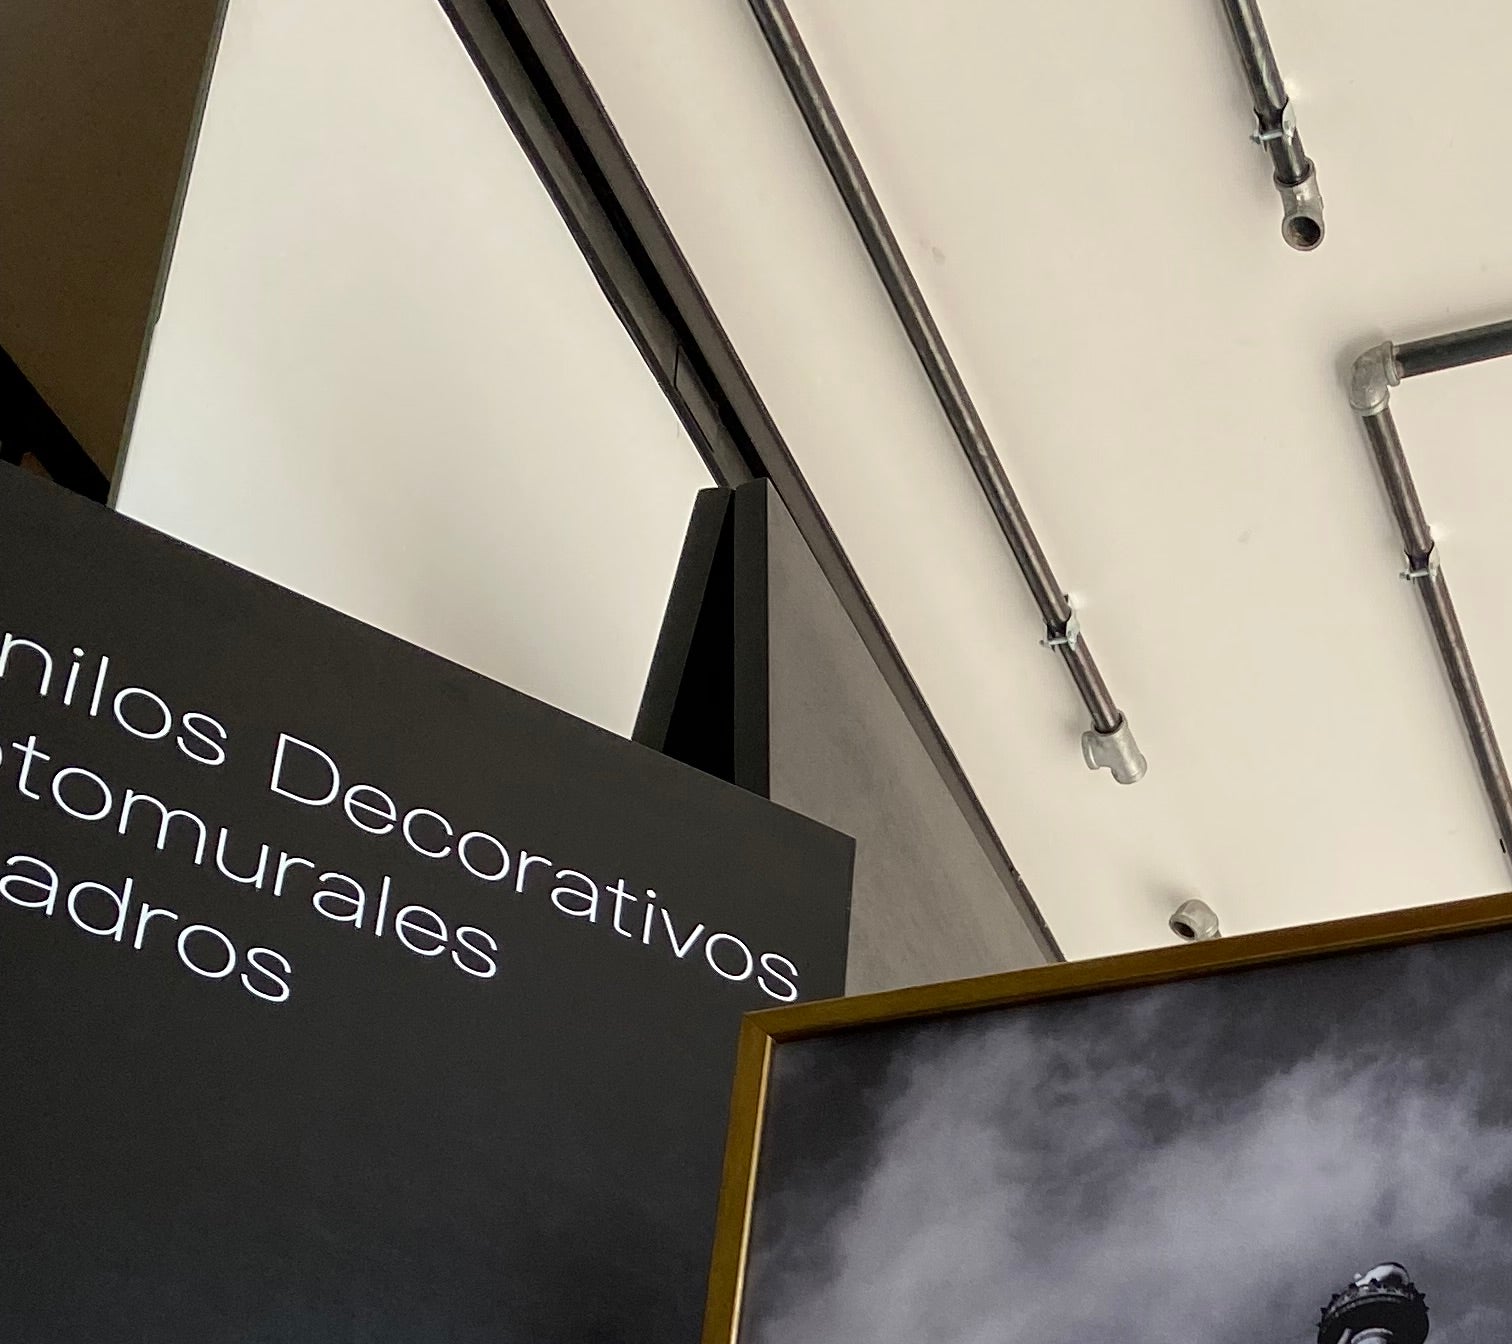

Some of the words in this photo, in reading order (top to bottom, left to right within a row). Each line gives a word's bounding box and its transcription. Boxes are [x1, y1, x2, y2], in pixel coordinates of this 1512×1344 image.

[0, 632, 228, 766] nilos
[270, 732, 799, 1003] Decorativos
[0, 735, 498, 979] tomurales
[0, 855, 292, 1003] adros
